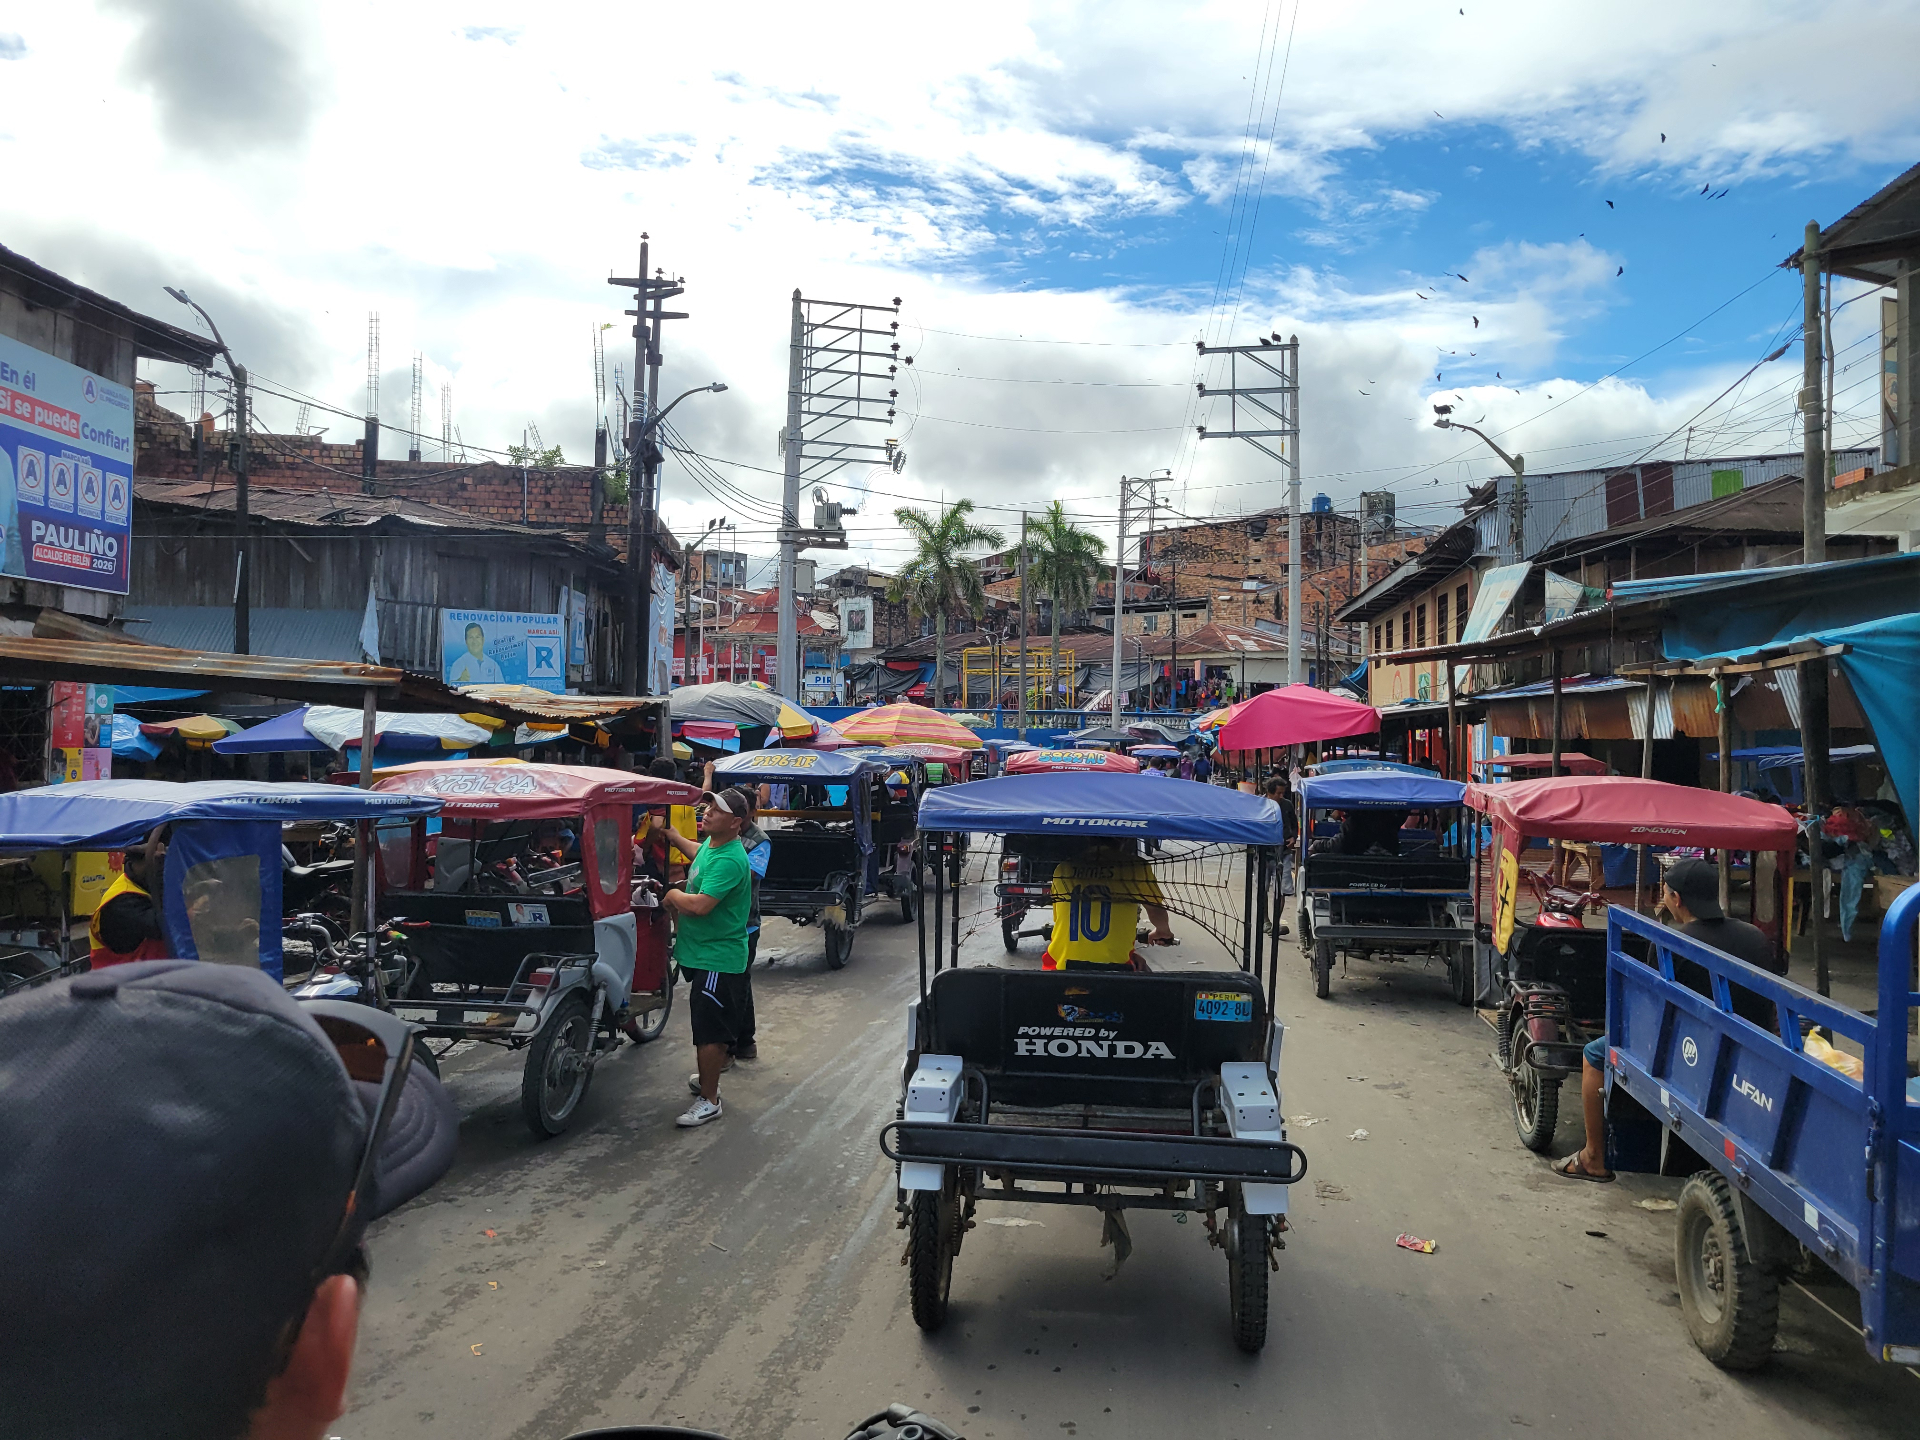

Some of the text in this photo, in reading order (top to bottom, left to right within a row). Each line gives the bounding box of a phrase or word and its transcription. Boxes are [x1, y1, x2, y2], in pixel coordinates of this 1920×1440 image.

[0, 361, 36, 391] En él
[14, 398, 31, 418] se
[34, 405, 78, 434] puede
[81, 421, 130, 453] Confiar!
[31, 520, 118, 557] PAULIÑO
[35, 547, 113, 571] ALCALDE DE BELÉN 2026
[449, 611, 559, 625] RENOVACIÓN POPULAR
[535, 646, 554, 669] R
[751, 754, 819, 769] 7196-1F
[1038, 751, 1107, 765] 5862-AC
[424, 774, 538, 795] 2751-CA
[445, 801, 500, 809] OTOKAR
[1042, 817, 1149, 829] MOTOKAR
[1630, 826, 1688, 836] ZONGSHEN
[1069, 884, 1112, 942] 10
[1213, 993, 1236, 1001] PERU
[1017, 1026, 1119, 1040] POWERED by
[1013, 1038, 1177, 1060] HONDA
[1732, 1073, 1774, 1113] LIFAN
